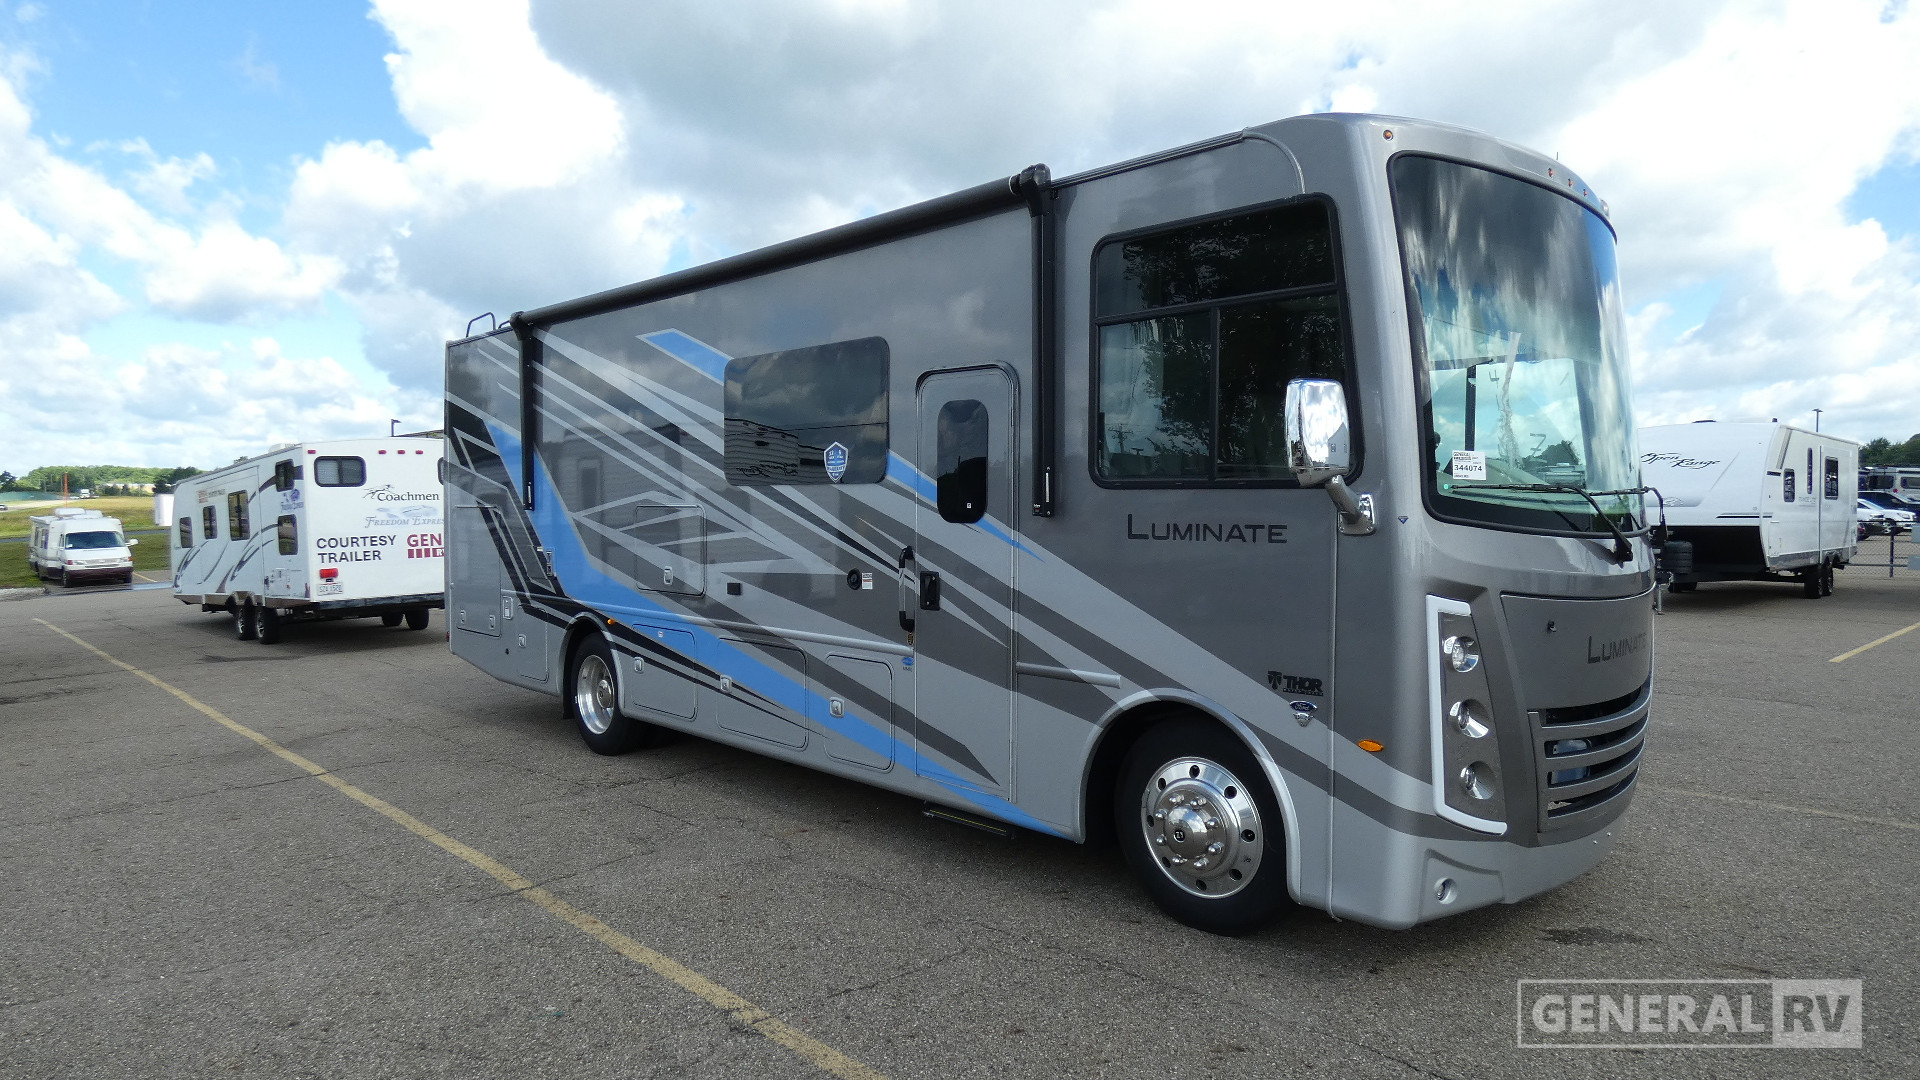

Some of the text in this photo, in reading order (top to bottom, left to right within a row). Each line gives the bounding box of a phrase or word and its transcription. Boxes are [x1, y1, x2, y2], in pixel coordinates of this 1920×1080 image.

[1641, 452, 1682, 464] Open
[1454, 464, 1482, 472] 344074
[377, 492, 440, 502] Coachmen
[1127, 513, 1288, 544] LUMINATE
[316, 534, 397, 549] COURTESY
[406, 533, 442, 547] GEN
[317, 550, 382, 563] TRAILER
[1283, 675, 1322, 692] THOR
